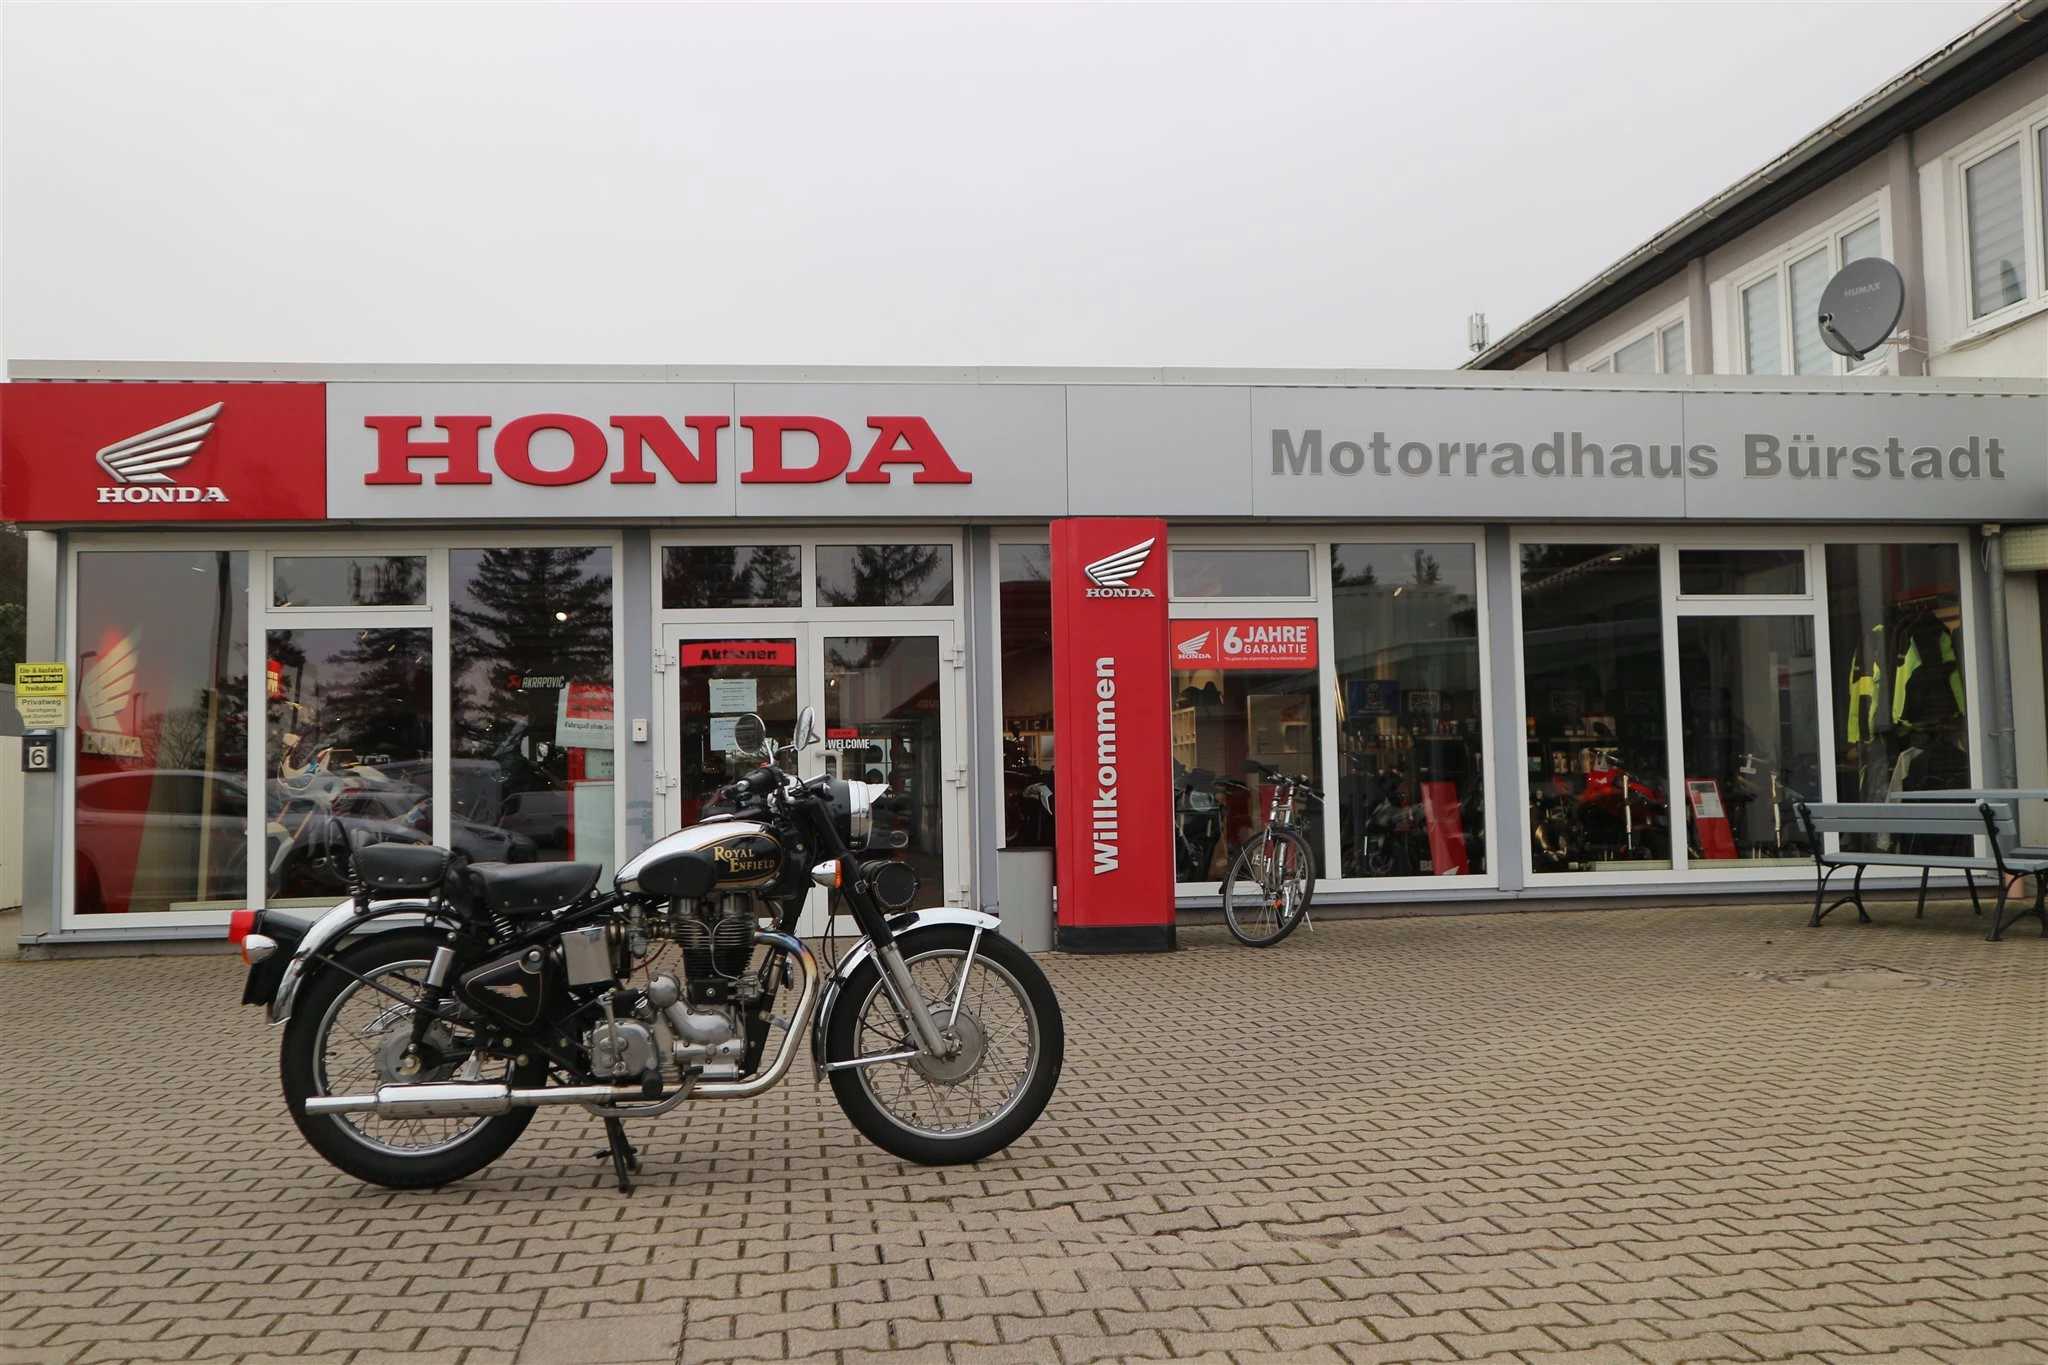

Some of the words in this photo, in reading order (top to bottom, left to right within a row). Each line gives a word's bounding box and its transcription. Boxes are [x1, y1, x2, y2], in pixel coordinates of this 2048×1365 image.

[1843, 281, 1881, 297] HUMAX
[364, 413, 973, 487] HONDA
[1270, 429, 1719, 478] Motorradhaus
[1743, 433, 2007, 480] Bürstadt
[96, 487, 230, 503] HONDA
[1086, 588, 1155, 598] HONDA
[1223, 626, 1243, 654] 6
[701, 648, 777, 660] Aktionen
[1244, 644, 1307, 654] GARANTIE
[21, 675, 32, 683] Tag
[827, 738, 870, 749] WELCOME
[31, 749, 45, 766] 6
[1093, 656, 1119, 875] Willkommen
[713, 846, 755, 862] ROYAL
[729, 858, 776, 873] ENFIELD
